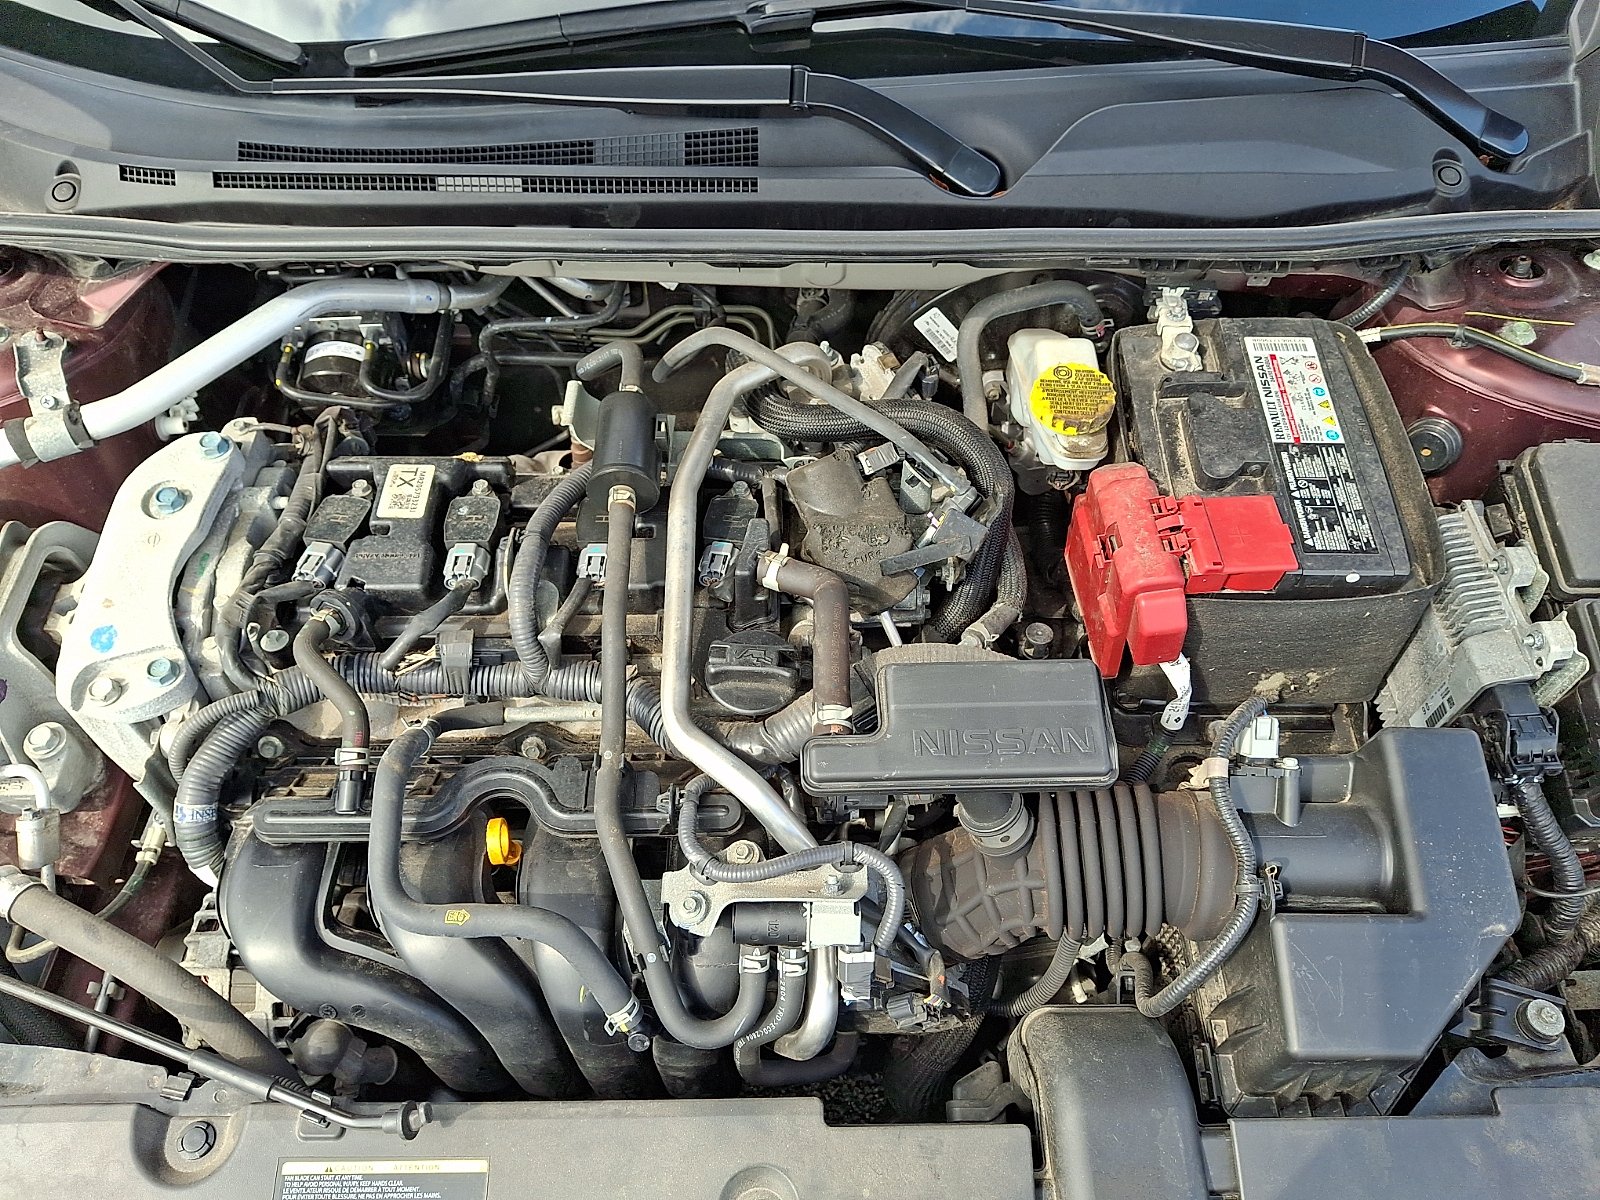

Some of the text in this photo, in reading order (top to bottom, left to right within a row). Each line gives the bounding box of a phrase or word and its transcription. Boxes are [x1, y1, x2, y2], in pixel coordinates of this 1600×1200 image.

[1253, 355, 1274, 398] NISSAN
[1265, 400, 1286, 441] RENAULT
[397, 468, 418, 488] TX
[912, 727, 1095, 757] NISSAN
[334, 1164, 374, 1172] CAUTION
